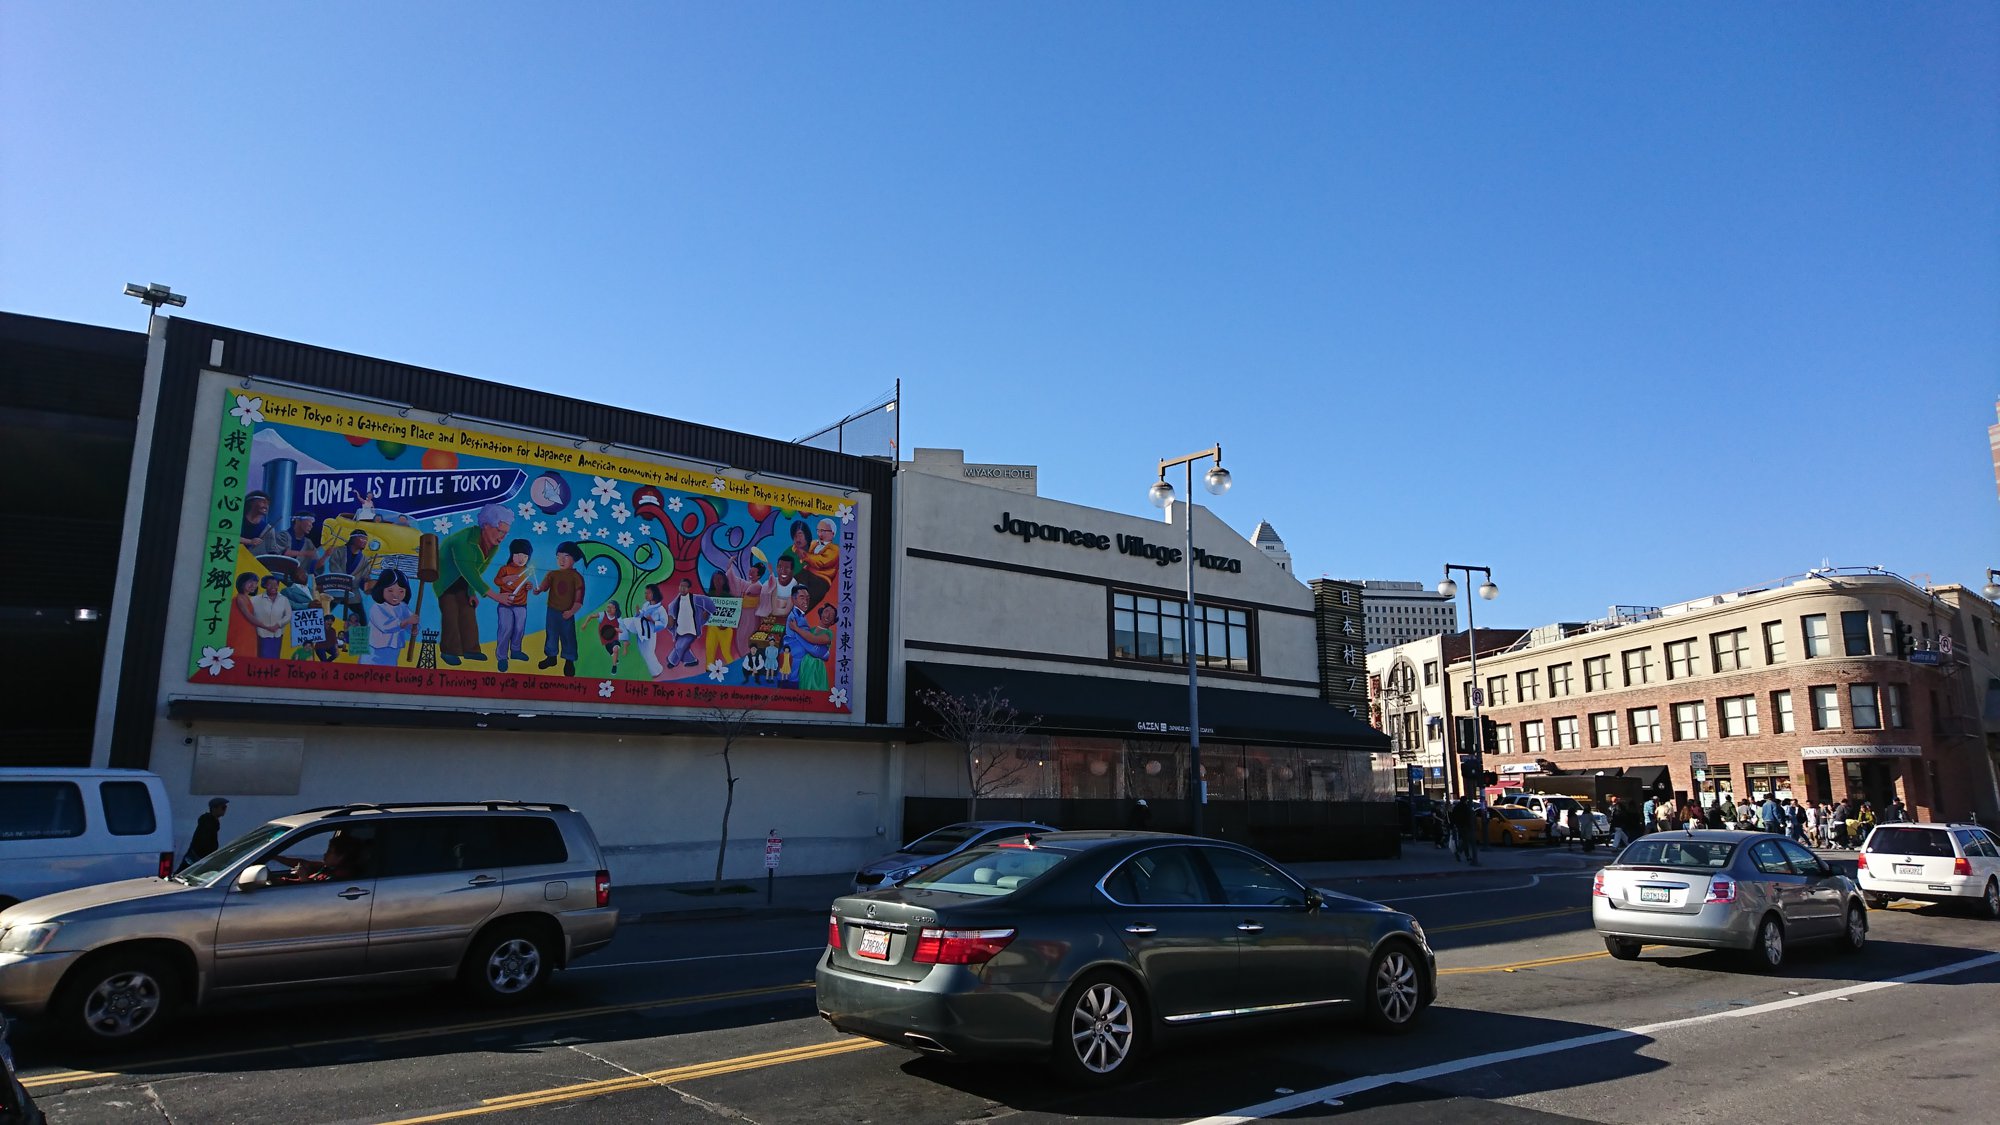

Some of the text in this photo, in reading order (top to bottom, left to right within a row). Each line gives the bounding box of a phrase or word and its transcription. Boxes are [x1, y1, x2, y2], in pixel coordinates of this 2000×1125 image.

[264, 400, 709, 488] Little Tokyo is a Gathering Place and Destination for Japanese American community and culture.
[964, 468, 1033, 479] MIYAKO HOTEL
[304, 475, 501, 506] HOME IS LITTLE TOKYO
[729, 481, 834, 513] Little Tokyo is a Spiritual Place.
[203, 430, 247, 636] 我々の心の故郷です
[994, 512, 1110, 550] Japanese
[1116, 533, 1182, 566] Village
[294, 618, 323, 627] LITTLE
[295, 610, 318, 620] SAVE
[838, 532, 855, 684] ロサンゼルスの小東京は
[247, 664, 587, 695] Little Tokyo is a complete Living & Thriving 100 year old community
[625, 682, 648, 697] Little
[652, 684, 674, 701] Tokyo
[677, 686, 684, 698] is
[686, 688, 691, 698] a
[1137, 722, 1159, 730] GAZEN
[1874, 746, 1905, 754] NATIONAL
